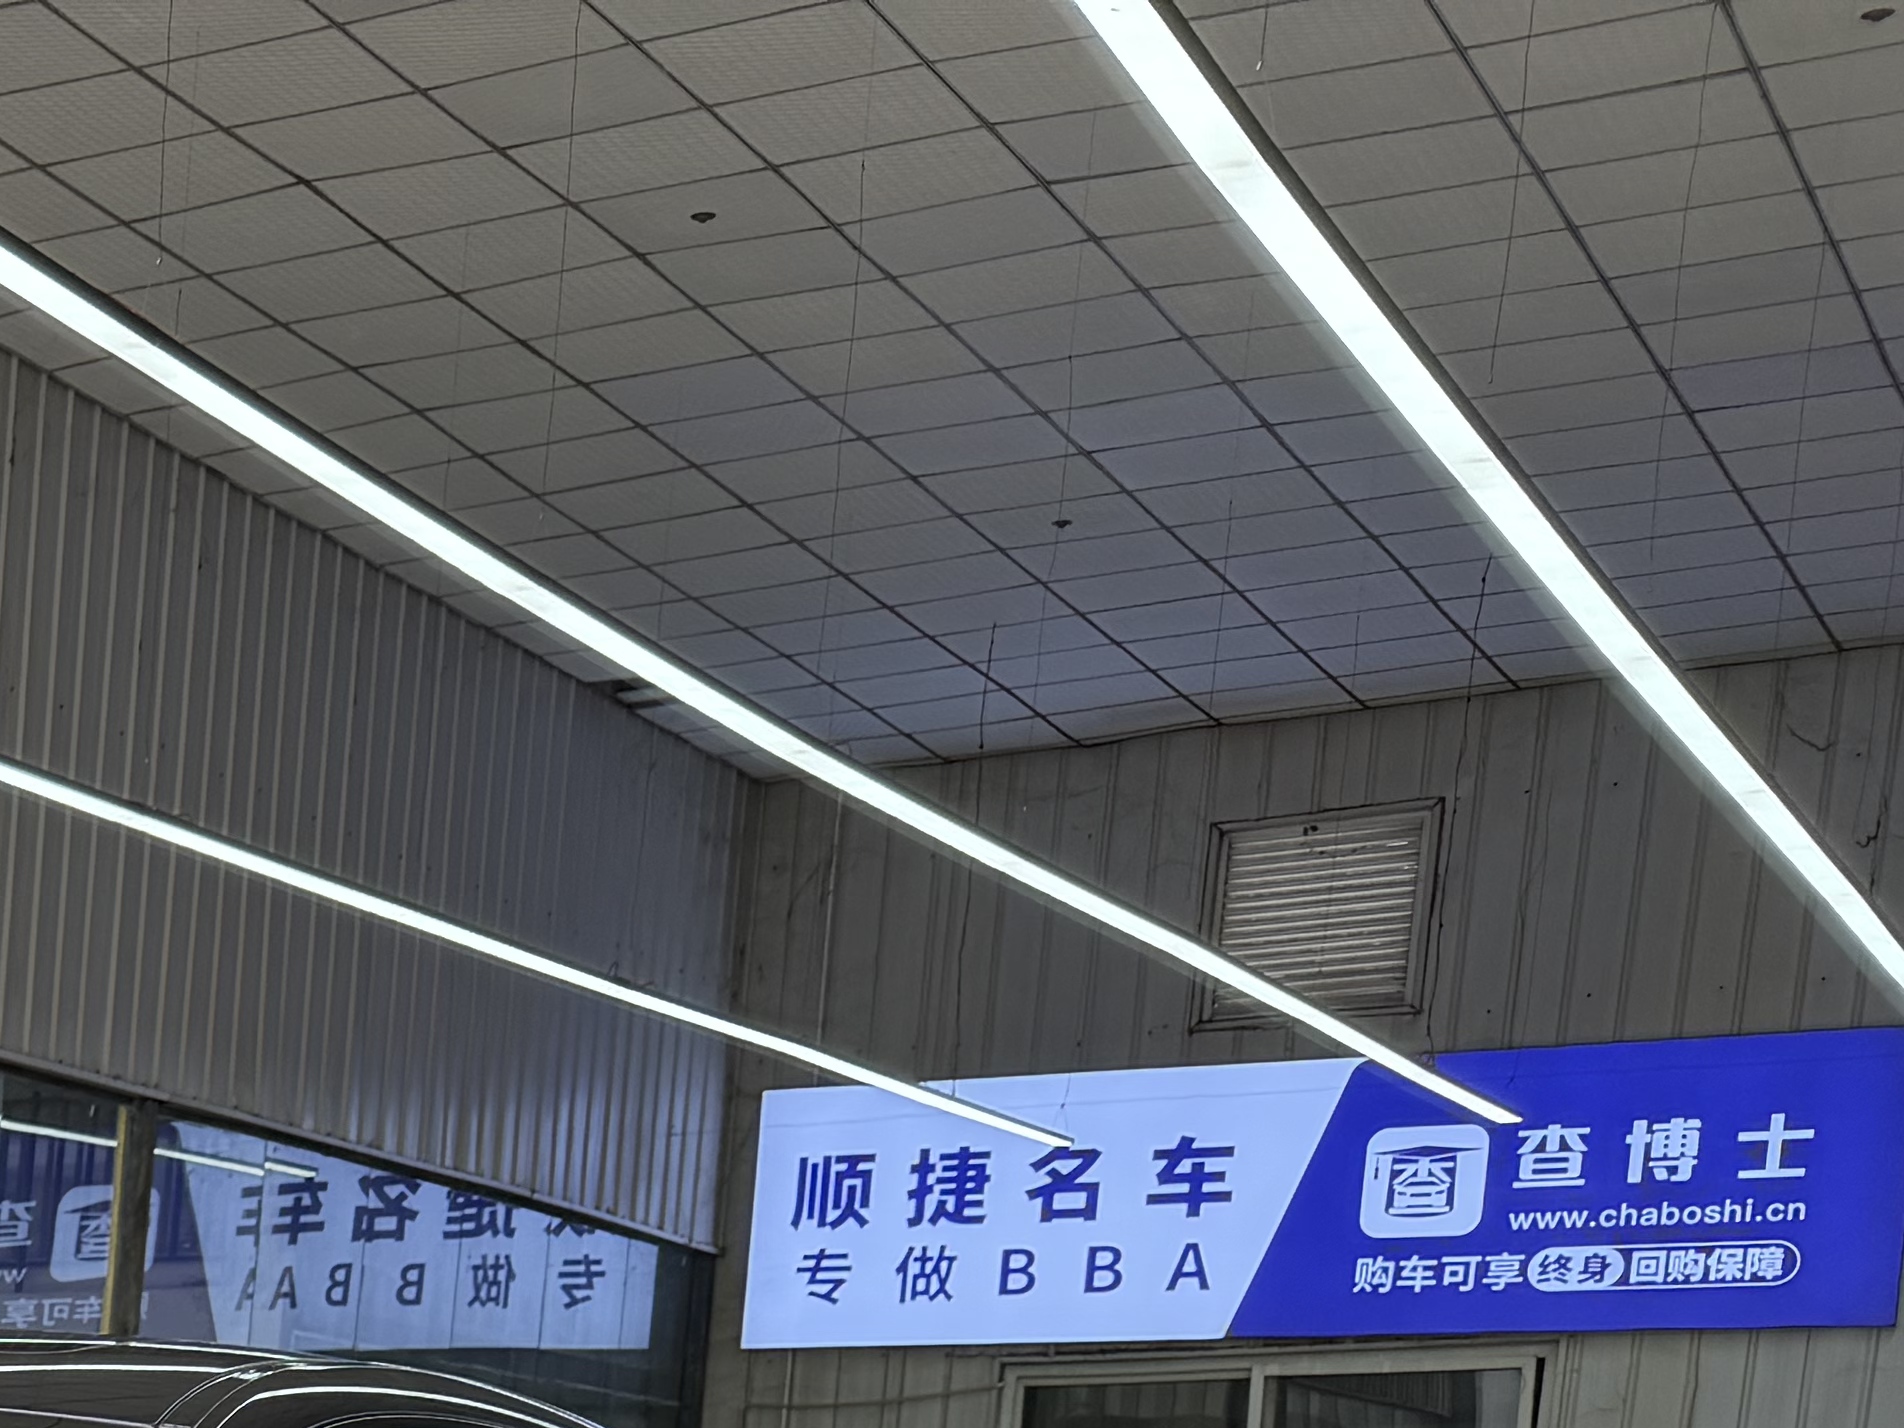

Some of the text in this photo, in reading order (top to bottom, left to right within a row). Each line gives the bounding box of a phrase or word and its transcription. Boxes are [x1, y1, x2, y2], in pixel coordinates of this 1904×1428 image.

[790, 1135, 1236, 1231] 顺捷名车
[1512, 1112, 1816, 1189] 查博士
[1508, 1197, 1807, 1232] www.chaboshi.cn
